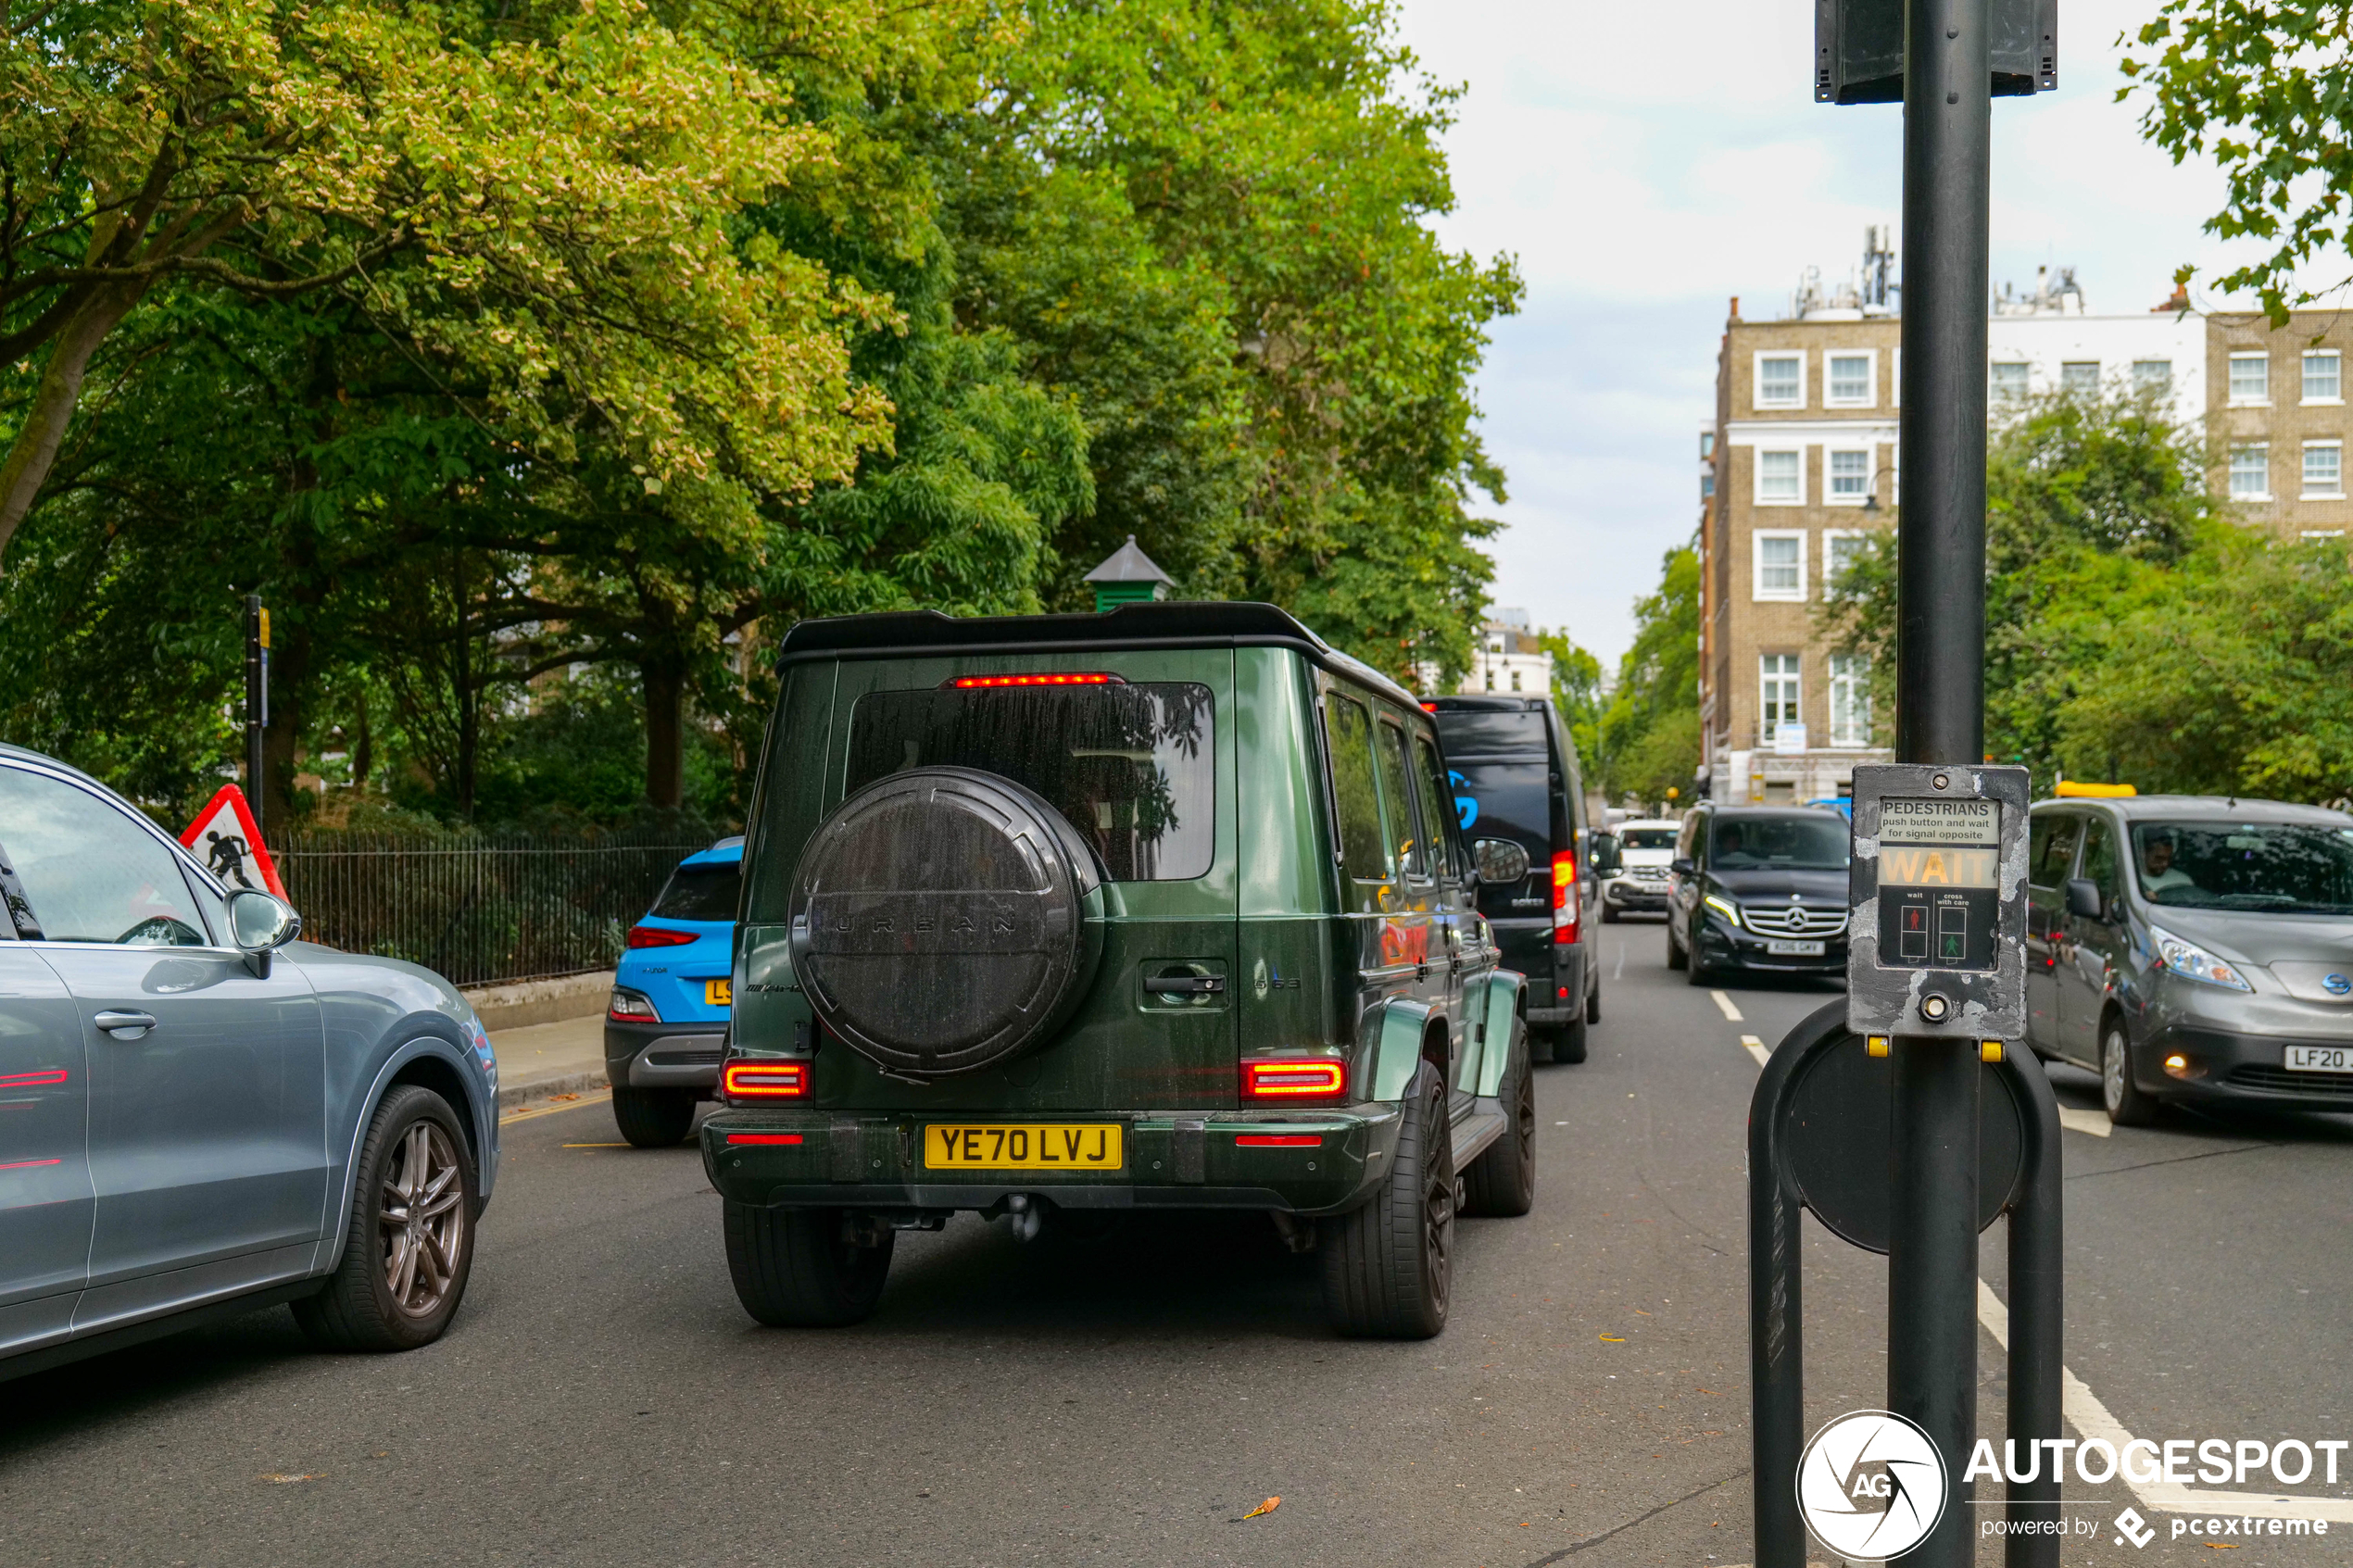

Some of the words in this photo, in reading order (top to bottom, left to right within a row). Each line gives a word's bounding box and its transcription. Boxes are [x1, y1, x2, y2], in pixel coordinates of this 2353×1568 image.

[1884, 802, 1989, 816] PEDESTRIANS
[1882, 818, 1906, 827] push
[1910, 818, 1943, 827] button
[1946, 819, 1965, 827] and
[1969, 820, 1990, 828] wait
[1889, 829, 1903, 837] for
[1906, 830, 1935, 840] signal
[1939, 831, 1983, 840] opposite
[1881, 851, 1989, 884] WAIT
[835, 915, 1016, 933] URBAN
[2295, 1048, 2344, 1067] LF20
[941, 1129, 1028, 1161] YE70
[1040, 1129, 1106, 1161] LVJ
